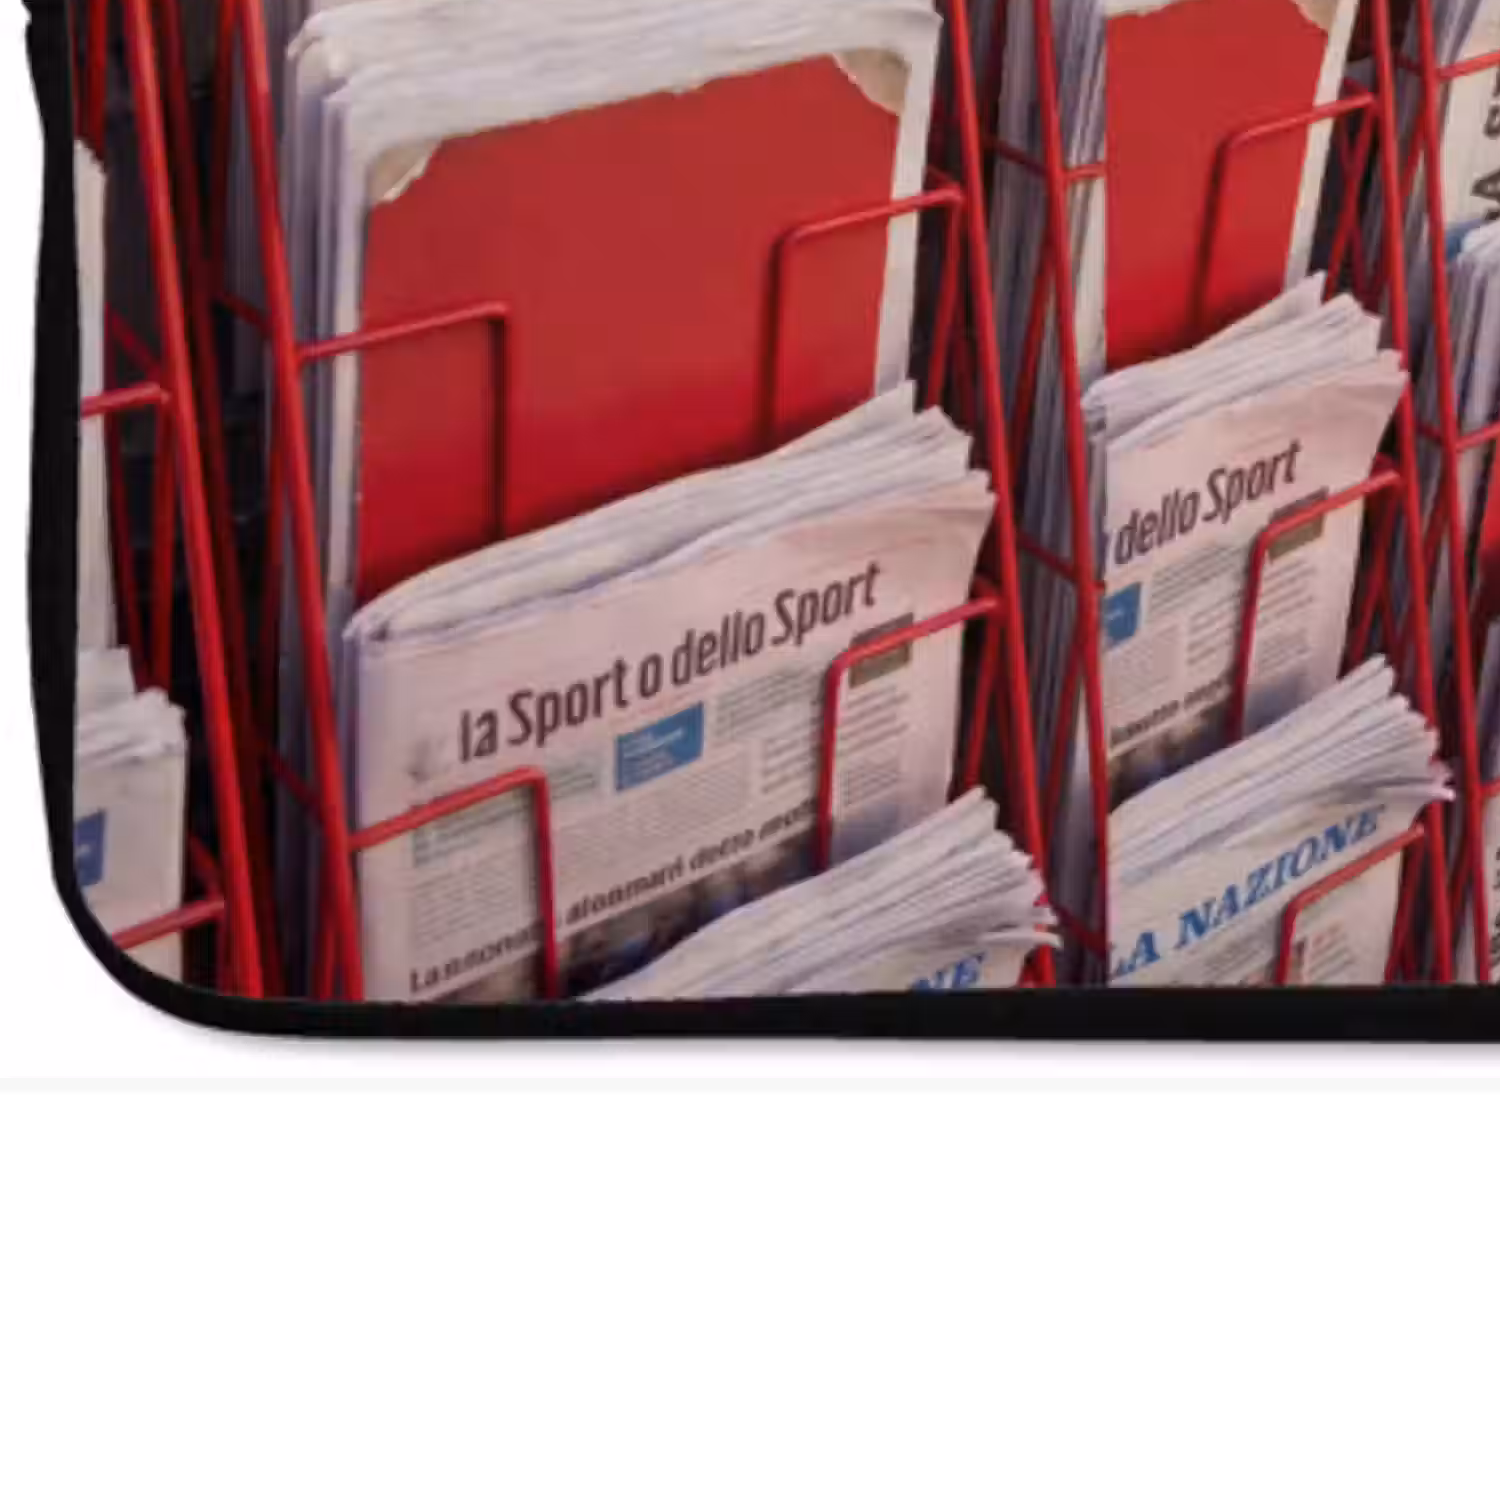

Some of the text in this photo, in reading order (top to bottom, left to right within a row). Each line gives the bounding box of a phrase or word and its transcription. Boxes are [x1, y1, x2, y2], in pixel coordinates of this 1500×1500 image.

[1114, 439, 1302, 565] dello Sport
[507, 657, 630, 749] Sport
[638, 652, 663, 700] o
[670, 610, 767, 686] dello
[770, 560, 881, 647] Sport
[1174, 803, 1386, 951] NAZIONE
